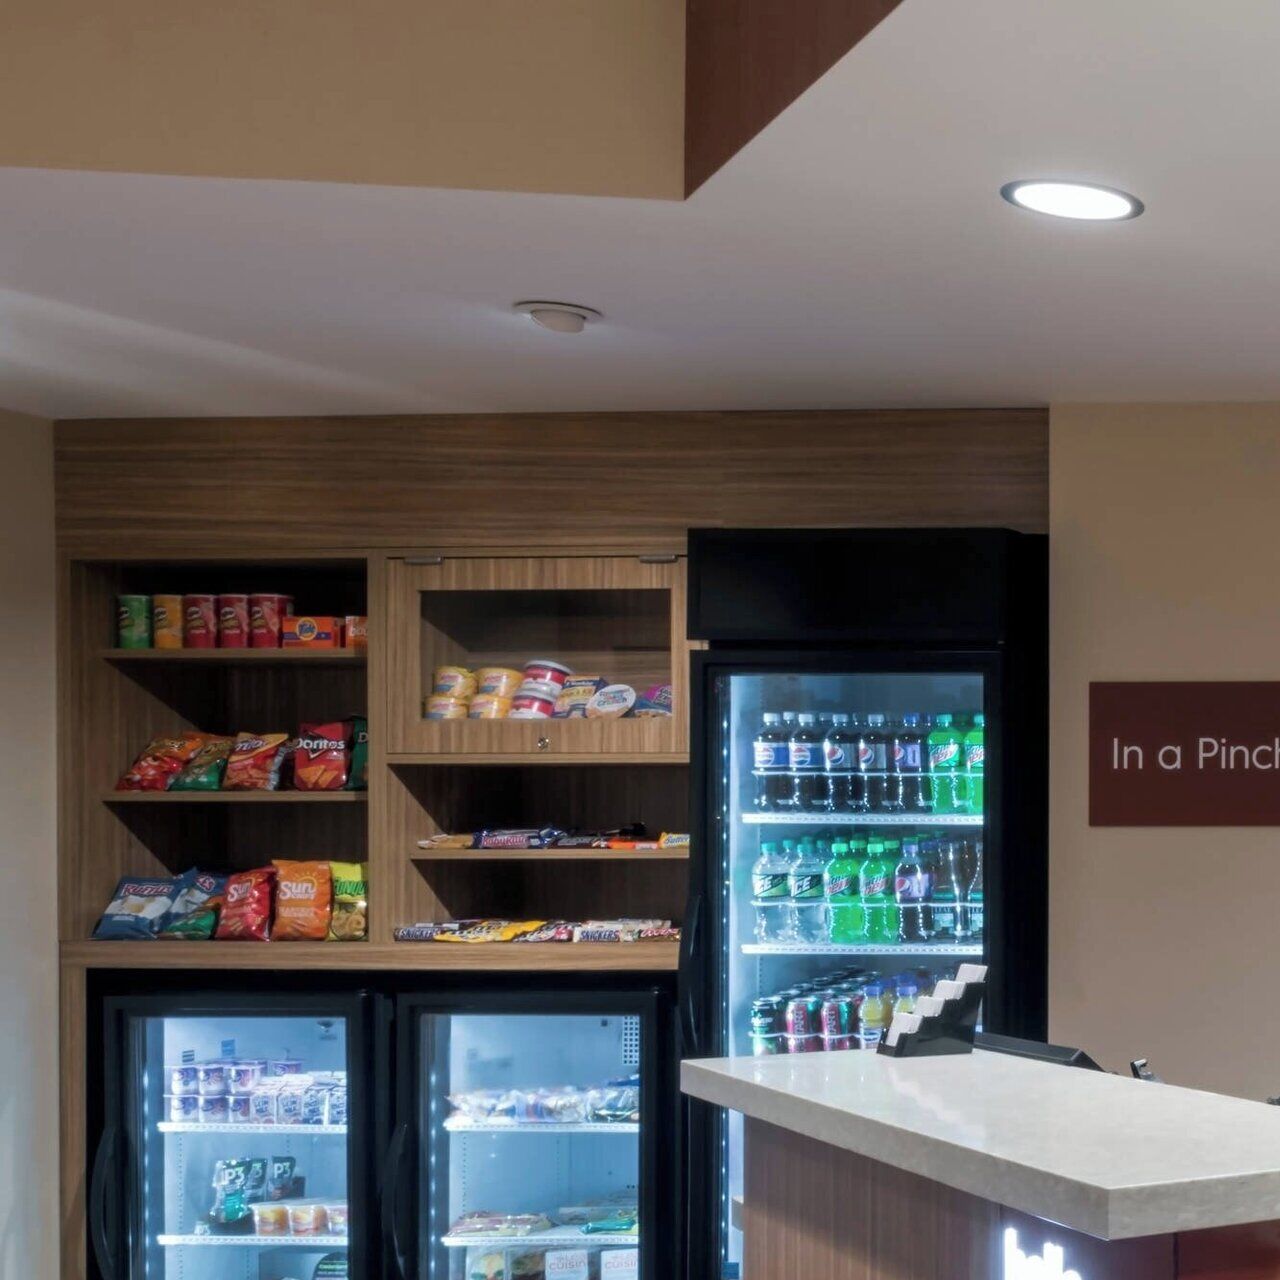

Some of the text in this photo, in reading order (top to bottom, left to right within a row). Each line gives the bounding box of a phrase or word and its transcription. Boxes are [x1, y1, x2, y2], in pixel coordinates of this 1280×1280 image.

[1112, 737, 1144, 770] In
[1158, 745, 1182, 770] a
[279, 880, 317, 900] Sun
